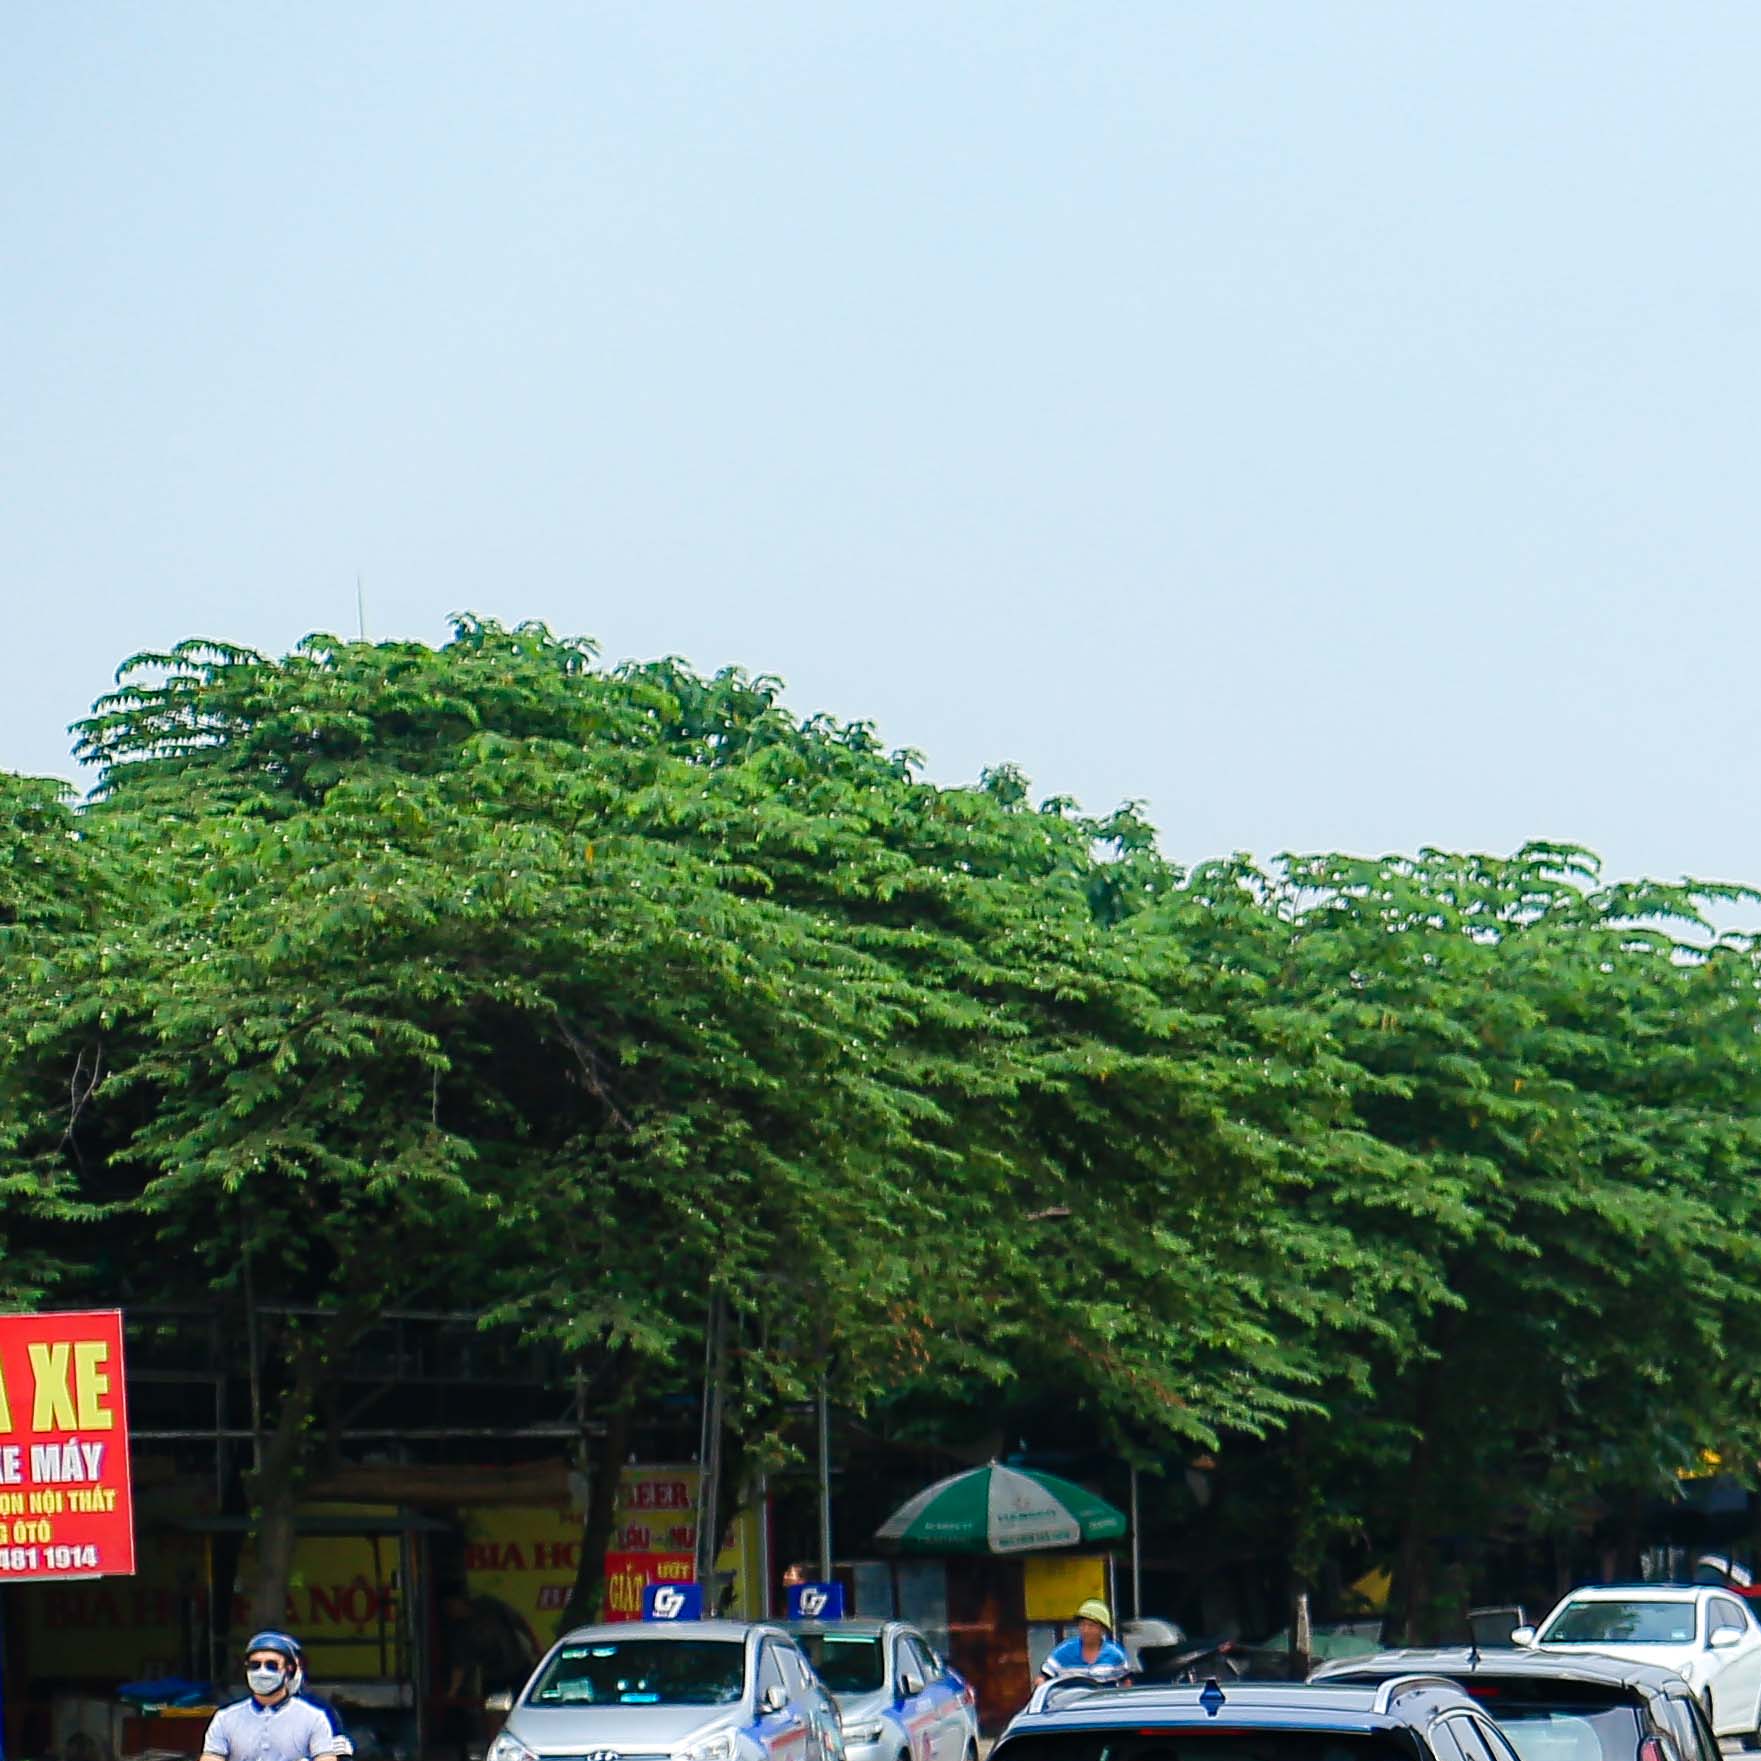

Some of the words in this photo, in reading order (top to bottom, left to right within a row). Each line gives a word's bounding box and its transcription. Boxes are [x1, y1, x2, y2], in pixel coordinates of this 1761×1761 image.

[27, 1341, 114, 1433] XE
[30, 1437, 105, 1484] MÁY
[29, 1489, 63, 1521] NỘI
[67, 1483, 117, 1513] THẤT
[13, 1518, 51, 1544] ÔTÔ
[43, 1544, 98, 1571] 1914
[654, 1586, 686, 1618] G7
